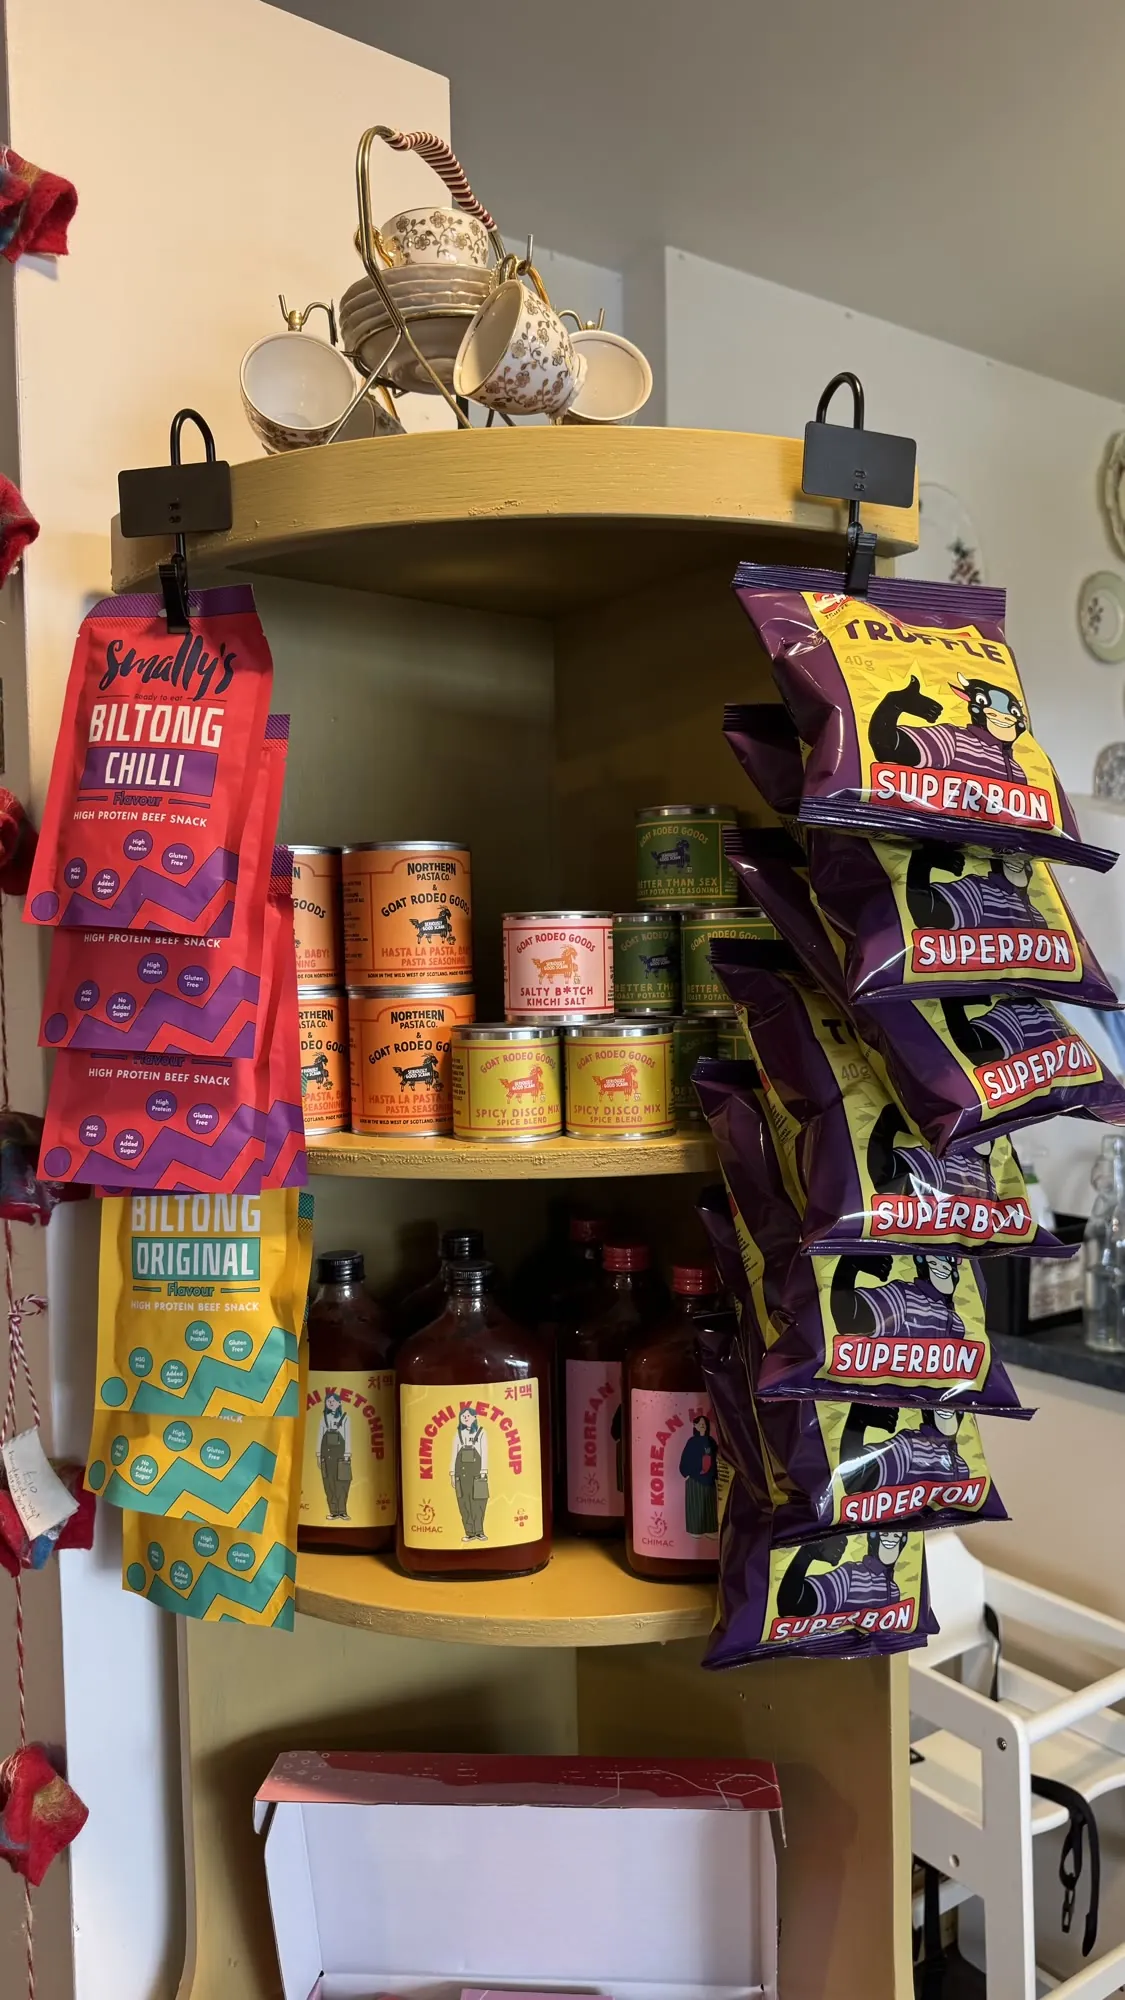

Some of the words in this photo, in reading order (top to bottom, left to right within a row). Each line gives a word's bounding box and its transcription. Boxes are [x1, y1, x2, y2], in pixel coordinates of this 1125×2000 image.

[845, 618, 1006, 665] TRUFFLE
[99, 631, 237, 702] Smally's
[844, 655, 875, 671] 40g
[134, 692, 157, 701] Ready
[88, 703, 225, 748] BILTONG
[104, 751, 185, 787] CHILLI
[112, 790, 163, 807] Flavour
[875, 768, 1050, 823] SUPERBON
[73, 810, 95, 820] HIGH
[98, 810, 138, 821] PROTEIN
[141, 812, 167, 823] BEEF
[169, 814, 208, 828] SNACK
[681, 827, 710, 845] GOODS
[132, 838, 146, 846] High
[168, 852, 188, 860] Gluten
[170, 859, 184, 867] Free
[407, 862, 457, 876] NORTHERN
[416, 873, 441, 881] PASTA
[666, 878, 695, 888] THAN
[699, 877, 718, 887] SEX
[650, 888, 675, 896] POTATO
[677, 887, 719, 895] SEASONING
[292, 898, 327, 919] GOODS
[380, 897, 407, 917] GOAT
[410, 893, 447, 905] RODEO
[449, 894, 471, 915] GOODS
[83, 933, 105, 943] HIGH
[108, 933, 151, 944] PROTEIN
[155, 936, 180, 945] BEEF
[184, 938, 222, 949] SNACK
[516, 936, 533, 954] GOAT
[535, 932, 567, 943] RODEO
[568, 933, 597, 952] GOODS
[690, 935, 706, 951] GOAT
[381, 947, 412, 958] HASTA
[415, 947, 428, 957] LA
[917, 932, 1071, 967] SUPERBON
[146, 961, 161, 969] High
[401, 958, 426, 967] PASTA
[142, 968, 163, 976] Protein
[183, 974, 204, 982] Gluten
[520, 987, 550, 997] SALTY
[112, 1003, 131, 1011] Added
[527, 998, 560, 1006] KIMCHI
[564, 997, 587, 1006] SALT
[112, 1010, 130, 1018] Sugar
[390, 1009, 445, 1025] NORTHERN
[400, 1020, 425, 1030] PASTA
[307, 1031, 313, 1039] &
[416, 1031, 422, 1039] &
[368, 1045, 391, 1065] GOAT
[394, 1040, 433, 1054] RODEO
[132, 1053, 186, 1068] Flavour
[480, 1056, 500, 1074] GOAT
[502, 1051, 534, 1063] RODEO
[535, 1052, 557, 1070] GOODS
[576, 1053, 594, 1070] GOAT
[595, 1049, 626, 1060] RODEO
[628, 1050, 657, 1069] GOODS
[840, 1062, 872, 1080] 40g
[88, 1067, 113, 1079] HIGH
[116, 1069, 161, 1081] PROTEIN
[164, 1071, 190, 1083] BEEF
[193, 1074, 231, 1087] SNACK
[155, 1098, 170, 1106] High
[368, 1094, 396, 1104] HASTA
[398, 1094, 410, 1104] LA
[151, 1105, 172, 1113] Protein
[385, 1105, 410, 1114] PASTA
[475, 1108, 507, 1118] SPICY
[512, 1107, 545, 1117] DISCO
[547, 1103, 560, 1115] MIX
[574, 1104, 600, 1115] SPICY
[604, 1105, 640, 1116] DISCO
[643, 1103, 661, 1114] MIX
[193, 1112, 213, 1120] Gluten
[496, 1118, 521, 1126] SPICE
[523, 1116, 548, 1125] BLEND
[590, 1115, 612, 1124] SPICE
[615, 1115, 643, 1123] BLEND
[119, 1147, 137, 1155] Sugar
[131, 1194, 261, 1232] BILTONG
[876, 1200, 1025, 1233] SUPERBON
[136, 1242, 254, 1276] ORIGINAL
[167, 1282, 215, 1297] Flavour
[131, 1300, 151, 1310] HIGH
[154, 1301, 194, 1312] PROTEIN
[198, 1301, 221, 1312] BEEF
[224, 1301, 260, 1312] SNACK
[189, 1335, 209, 1343] Protein
[836, 1342, 981, 1374] SUPERBON
[504, 1384, 533, 1402] 치맥
[324, 1386, 385, 1461] KETCHUP
[583, 1382, 615, 1467] KOREAN
[172, 1429, 185, 1437] High
[168, 1435, 187, 1444] Protein
[419, 1405, 457, 1480] KIMCHI
[459, 1400, 523, 1476] KETCHUP
[206, 1446, 225, 1455] Gluten
[208, 1453, 220, 1461] Free
[650, 1413, 684, 1506] KOREAN
[136, 1465, 153, 1474] Added
[134, 1472, 151, 1480] Sugar
[411, 1524, 444, 1534] CHIMAC
[197, 1541, 215, 1549] Protein
[641, 1537, 675, 1547] CHIMAC
[232, 1550, 250, 1558] Gluten
